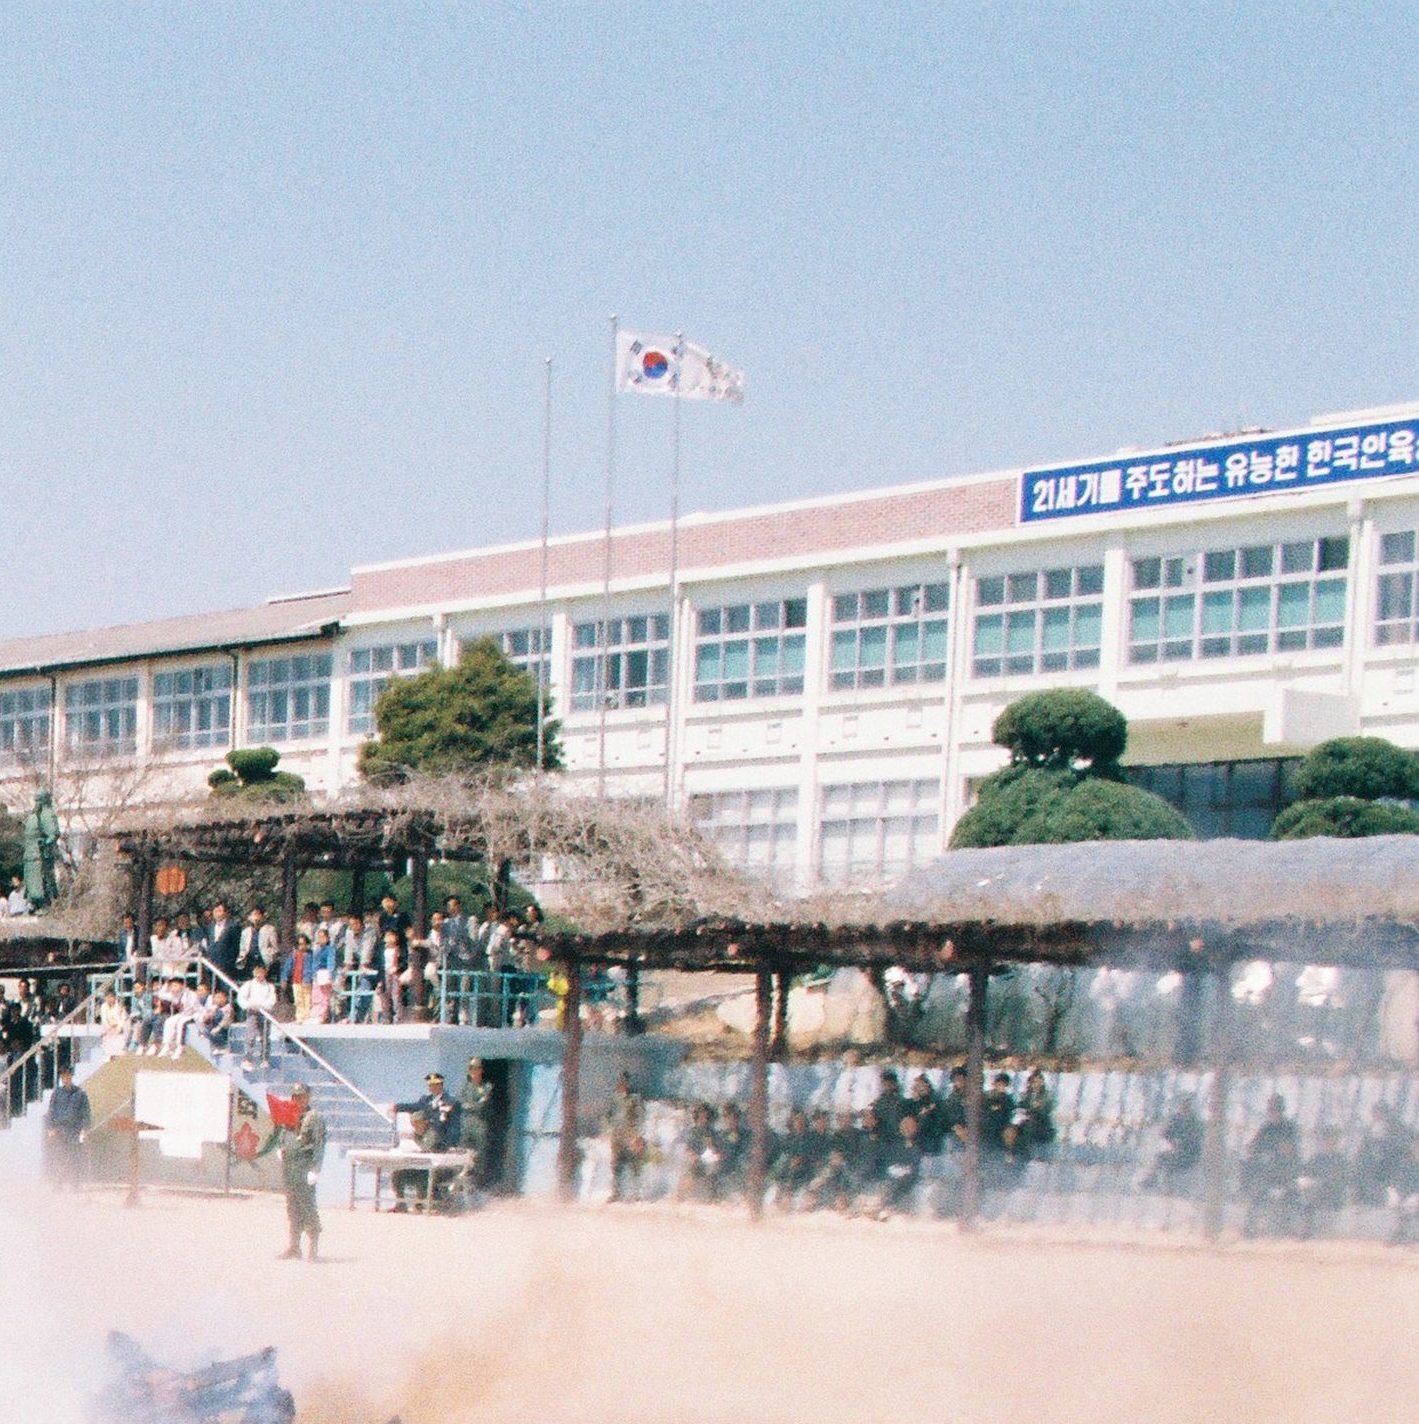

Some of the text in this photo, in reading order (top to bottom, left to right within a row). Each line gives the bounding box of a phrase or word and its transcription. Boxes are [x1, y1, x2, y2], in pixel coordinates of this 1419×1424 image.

[1125, 458, 1219, 500] 주도하는
[1225, 444, 1300, 488] 유능한
[1307, 430, 1419, 477] 한국인육
